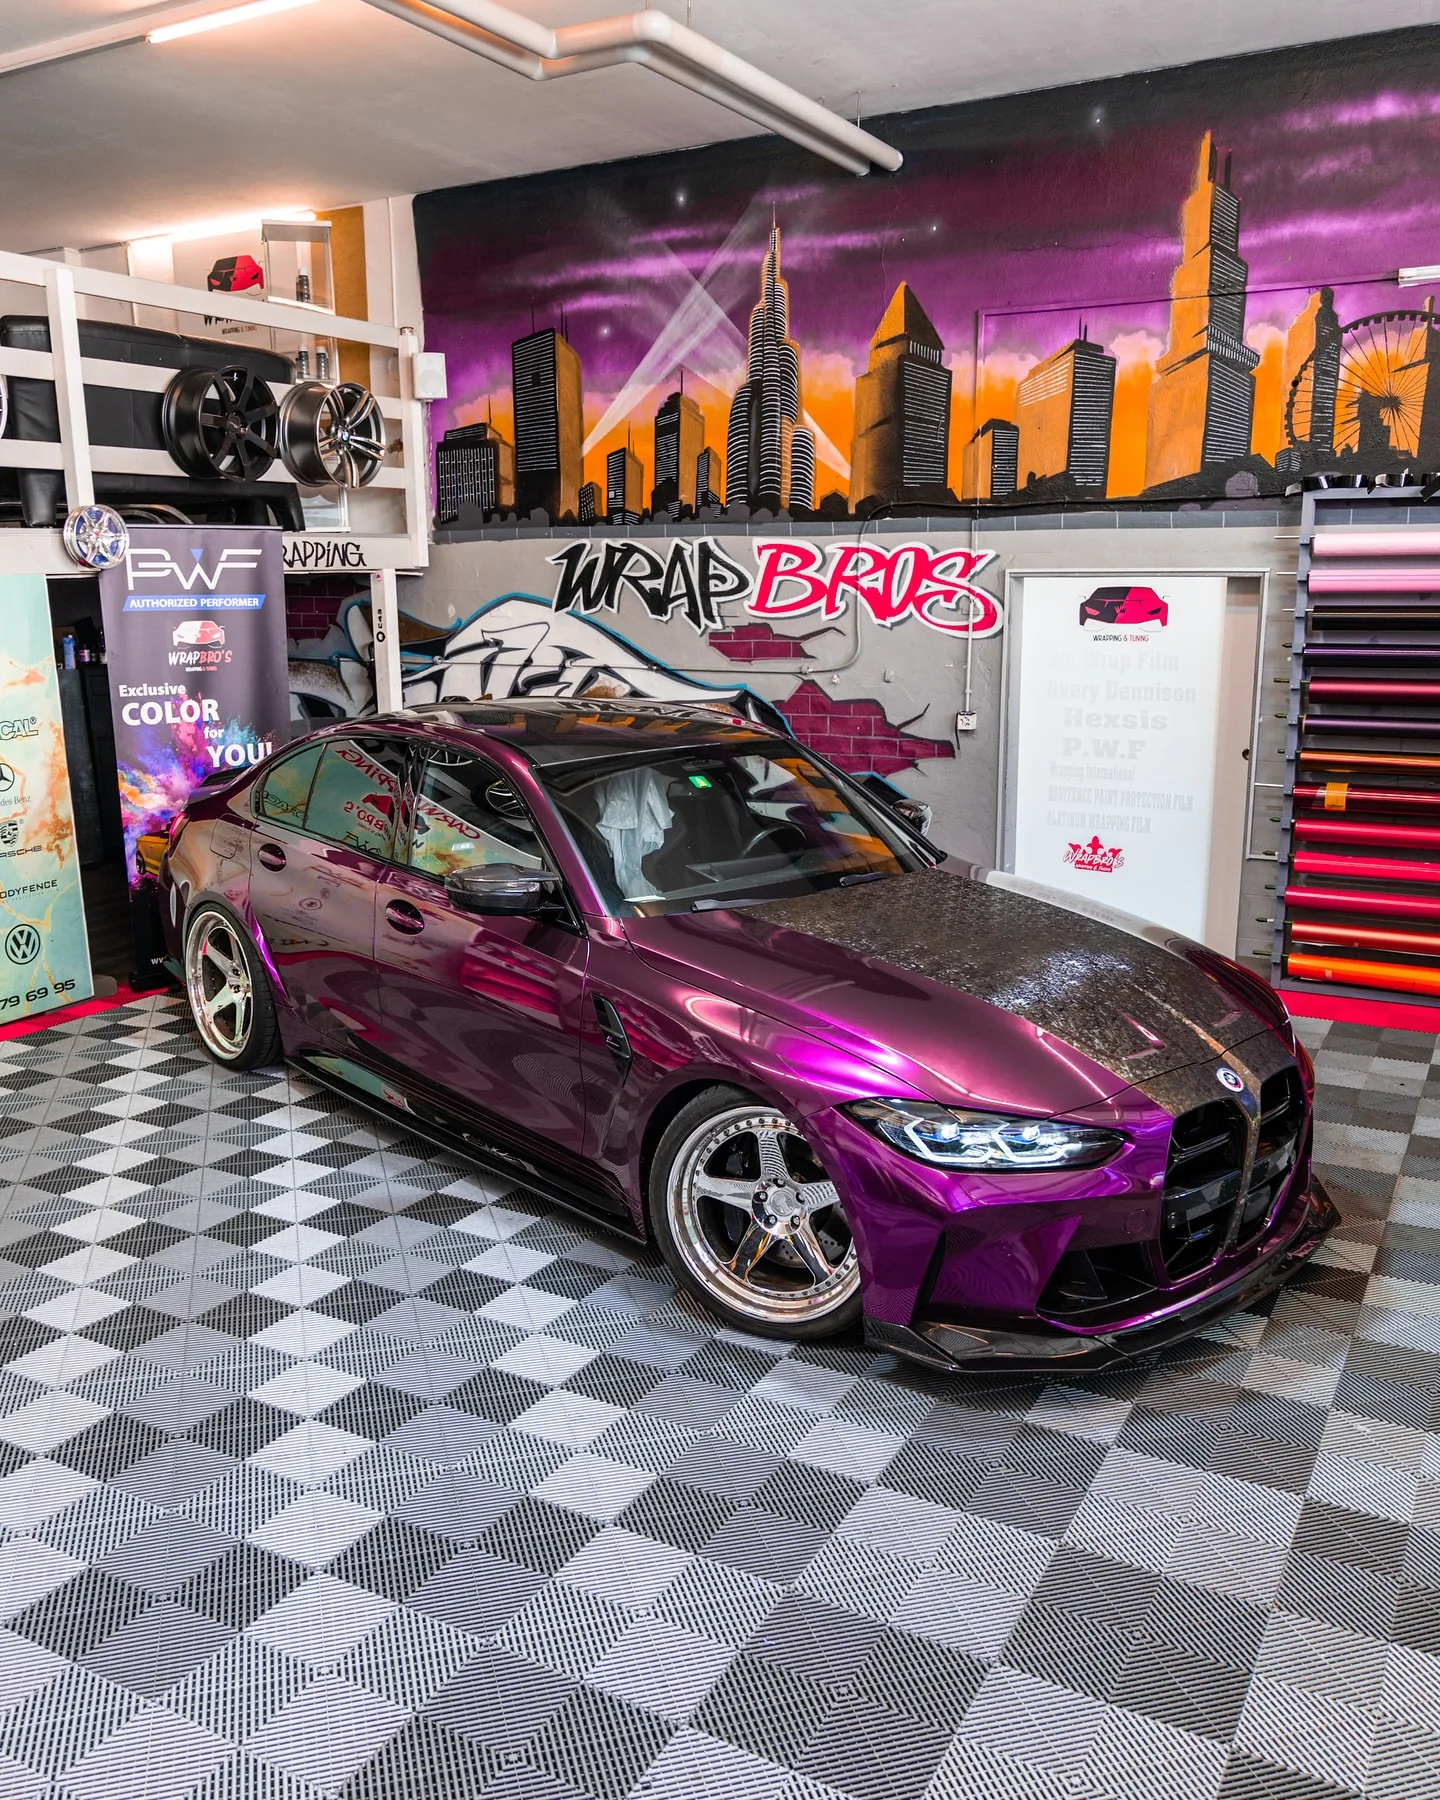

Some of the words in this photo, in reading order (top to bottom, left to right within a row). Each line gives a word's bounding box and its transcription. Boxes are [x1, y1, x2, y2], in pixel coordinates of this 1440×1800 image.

[126, 548, 262, 590] PWF
[548, 537, 751, 633] WRAP
[748, 537, 1003, 637] BROS
[129, 598, 198, 609] AUTHORIZED
[200, 597, 259, 607] PERFORMER
[1092, 634, 1122, 642] WRAPPING
[1129, 634, 1150, 642] TUNING
[1083, 649, 1131, 674] Wrap
[1137, 650, 1180, 672] Film
[118, 682, 187, 698] Exclusive
[1046, 679, 1101, 704] Avery
[1105, 680, 1197, 703] Dennison
[122, 699, 220, 726] COLOR
[1063, 706, 1168, 731] Hexsis
[204, 726, 224, 739] for
[1062, 737, 1147, 760] P.W.F
[1049, 760, 1085, 783] Wrapping
[1086, 762, 1136, 782] International
[1094, 788, 1119, 807] PAINT
[1120, 790, 1172, 811] PROTECTION
[1173, 794, 1194, 812] FILM
[1047, 809, 1087, 829] PLATINUM
[1088, 812, 1130, 833] WRAPPING
[1131, 816, 1151, 834] FILM
[0, 995, 20, 1010] 79
[26, 987, 48, 1002] 69
[53, 979, 76, 994] 95
